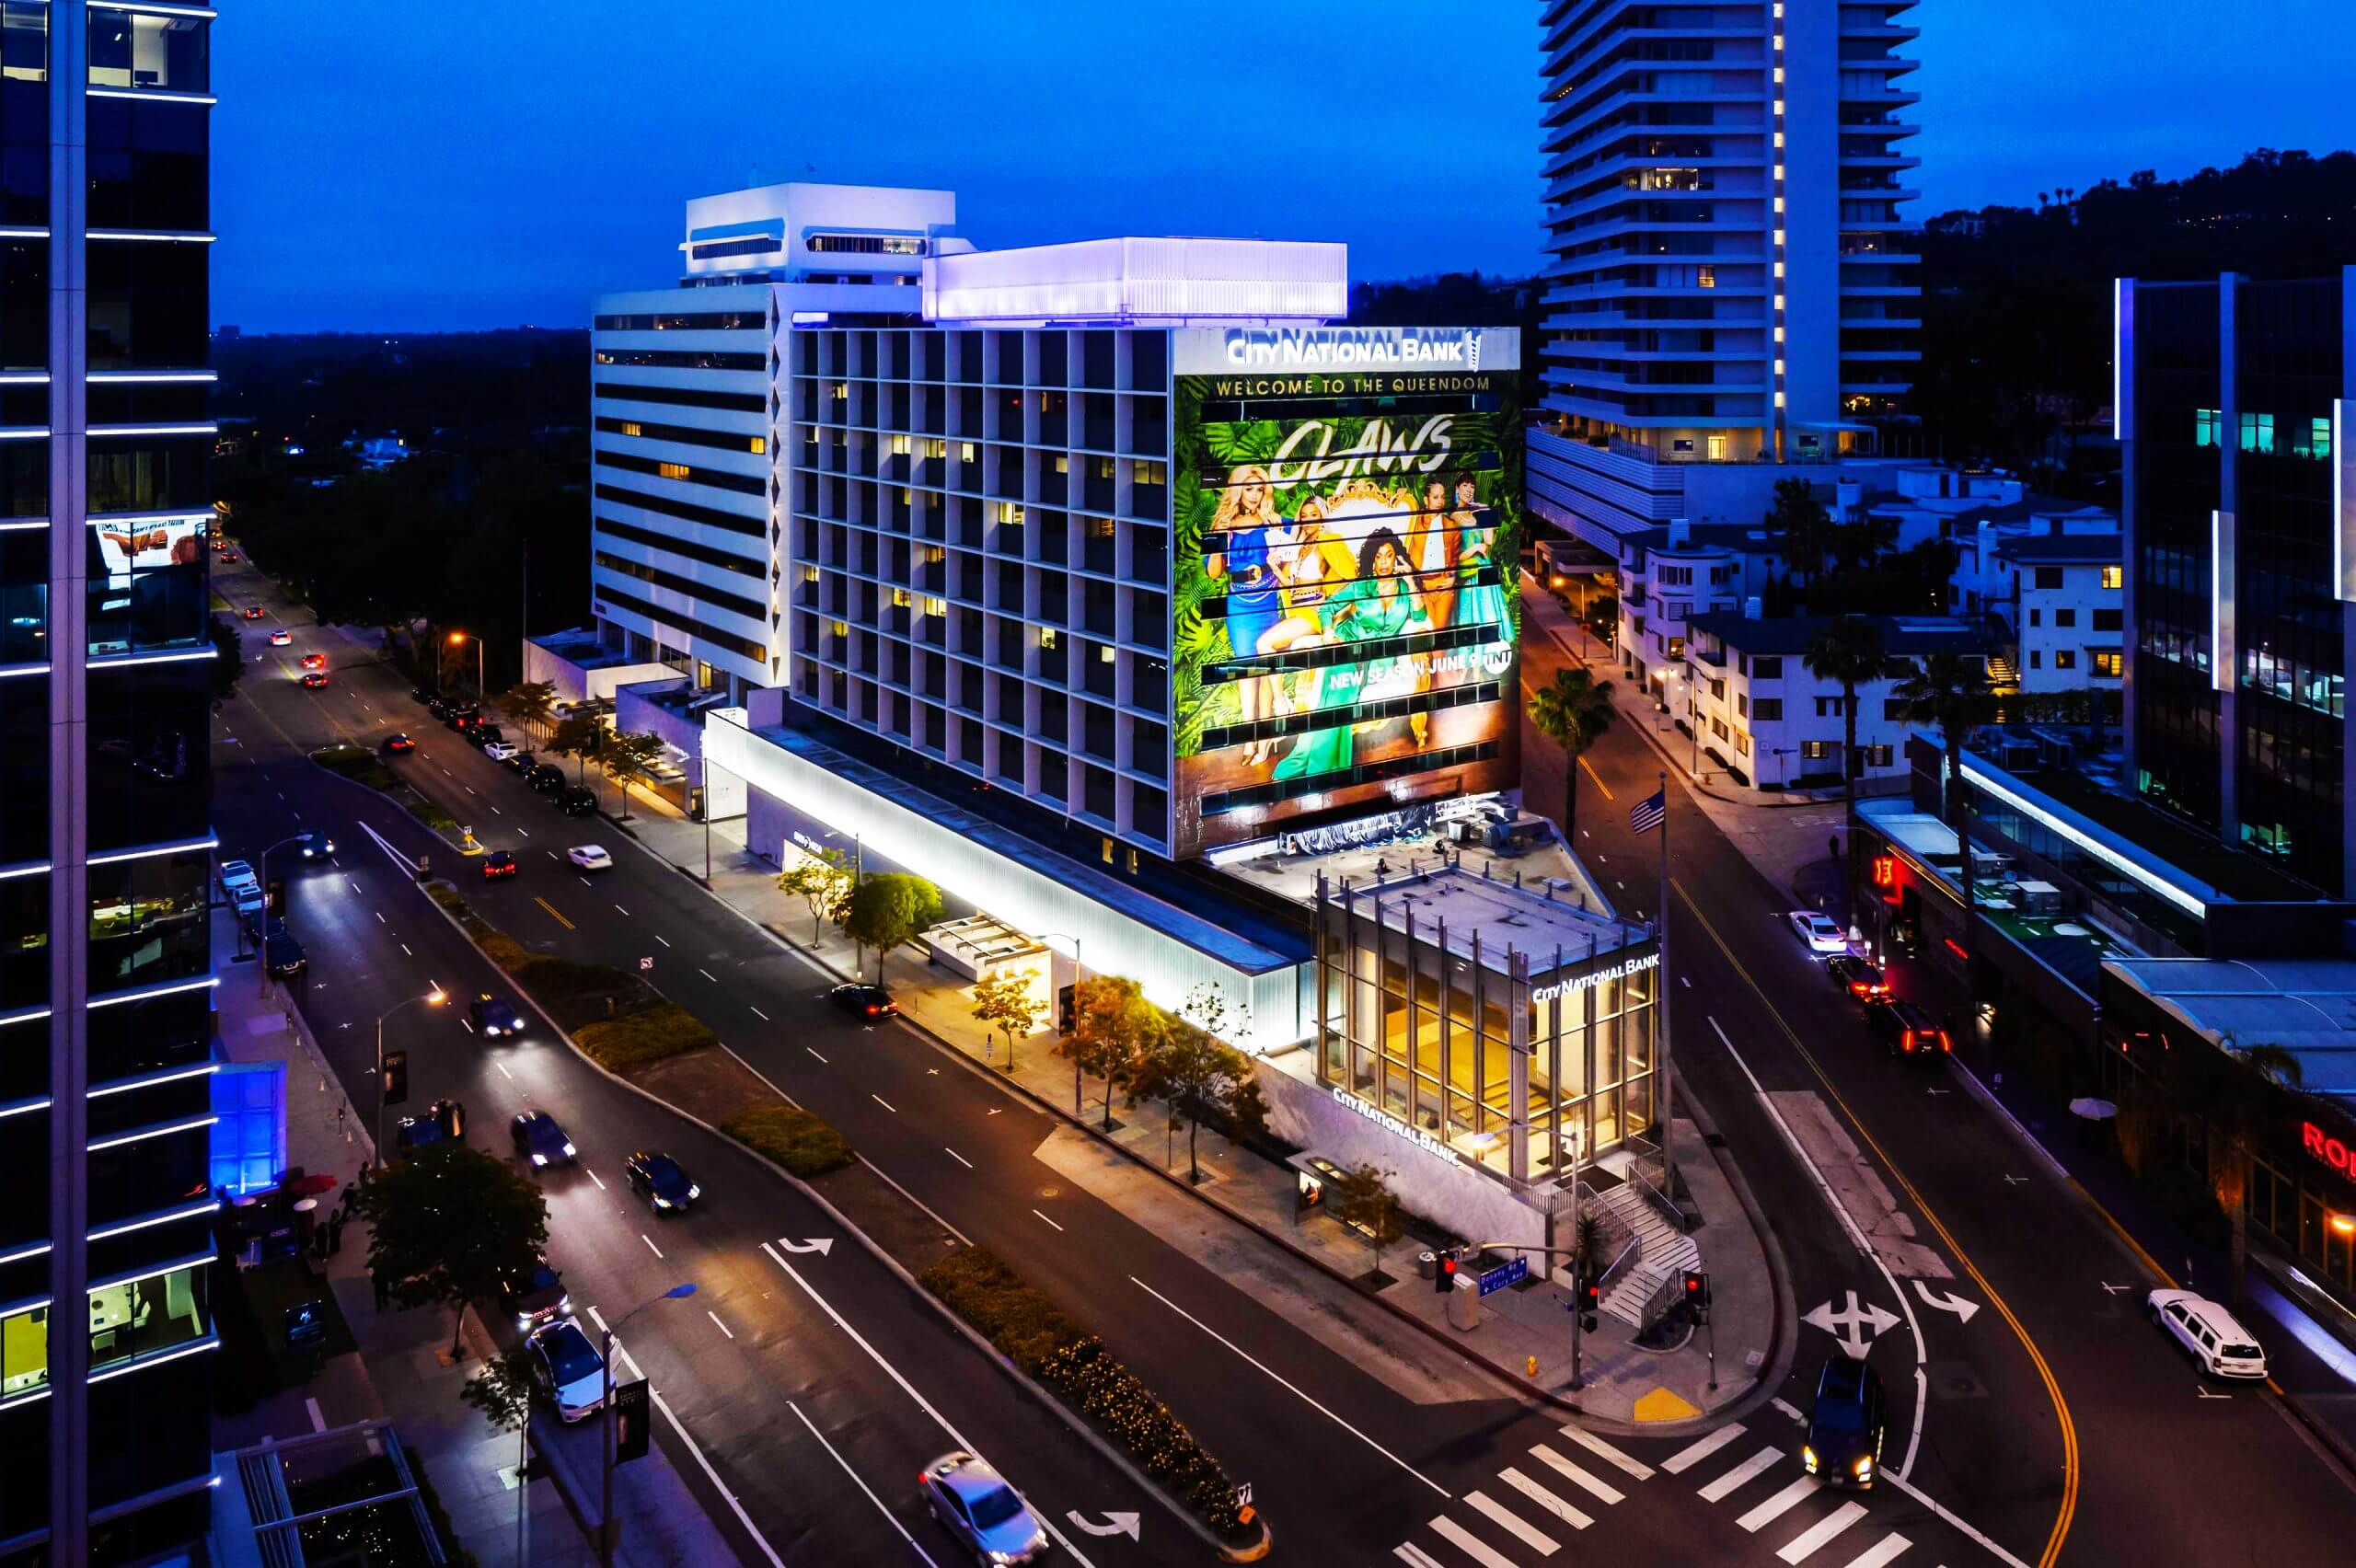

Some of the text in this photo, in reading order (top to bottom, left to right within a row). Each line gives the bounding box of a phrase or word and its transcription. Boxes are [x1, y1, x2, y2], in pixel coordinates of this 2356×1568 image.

[1227, 338, 1463, 365] CITY NATIONAL BANK
[1217, 376, 1490, 397] WELCOME TO THE QUEENDOM
[1269, 413, 1456, 497] CLAWS
[1330, 669, 1363, 689] NEW
[1368, 660, 1425, 684] SEASON
[1429, 653, 1466, 674] JUNE
[1483, 649, 1512, 666] TNT
[1532, 953, 1660, 1003] CITY NATIONAL BANK
[1333, 1087, 1460, 1165] CITY NATIONAL BANK
